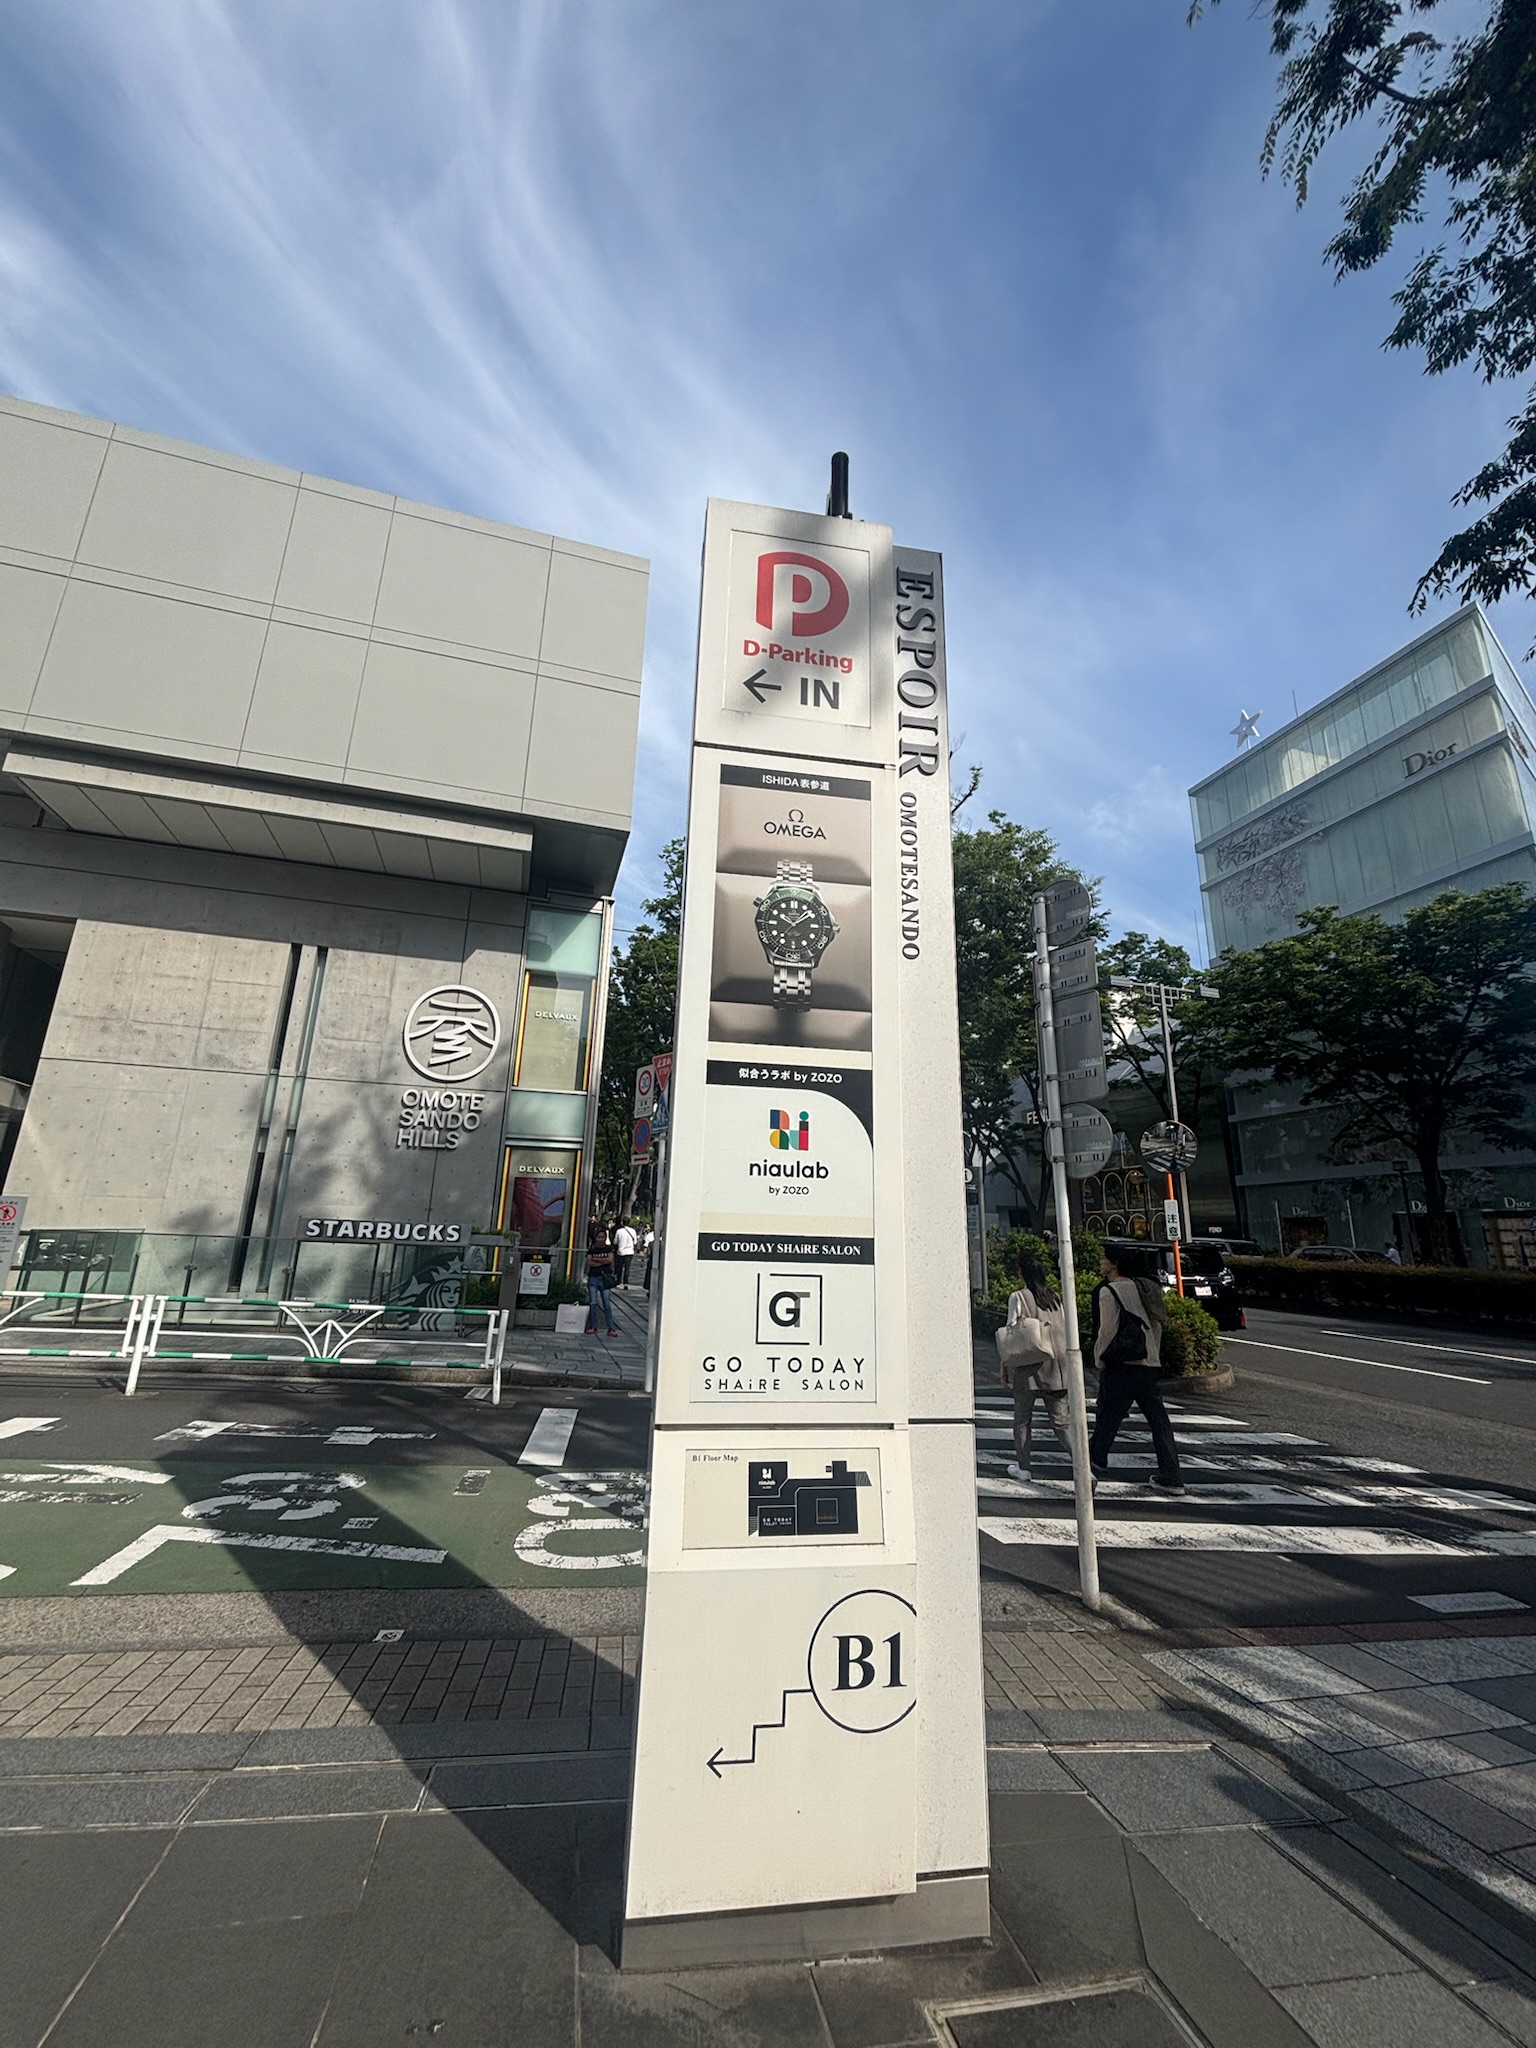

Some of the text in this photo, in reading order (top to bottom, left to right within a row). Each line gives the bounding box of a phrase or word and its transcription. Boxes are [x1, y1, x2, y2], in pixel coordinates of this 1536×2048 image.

[743, 640, 853, 674] D-Parking
[896, 566, 939, 778] ESPOIR
[800, 677, 840, 710] IN
[1402, 742, 1457, 779] Dior
[763, 821, 827, 840] OMEGA
[899, 792, 921, 961] OMOTESANDO
[535, 1010, 578, 1021] DELVAUX
[738, 1067, 843, 1084] 似合うラボ by ZOZO
[402, 1089, 485, 1112] OMOTE
[398, 1109, 481, 1131] SANDO
[396, 1128, 460, 1150] HILLS
[518, 1165, 565, 1174] DELVAUX
[749, 1159, 829, 1180] niaulab
[769, 1184, 810, 1196] by ZOZO
[1503, 1196, 1532, 1209] Dior
[306, 1219, 460, 1241] STARBUCKS
[1167, 1213, 1179, 1238] 注意
[711, 1241, 731, 1252] GO
[732, 1241, 775, 1254] TODAY
[821, 1244, 862, 1256] SALON
[703, 1356, 866, 1374] GO TODAY
[802, 1379, 865, 1391] SALON
[703, 1454, 722, 1462] Floor
[723, 1454, 739, 1463] Map
[832, 1631, 907, 1691] B1
